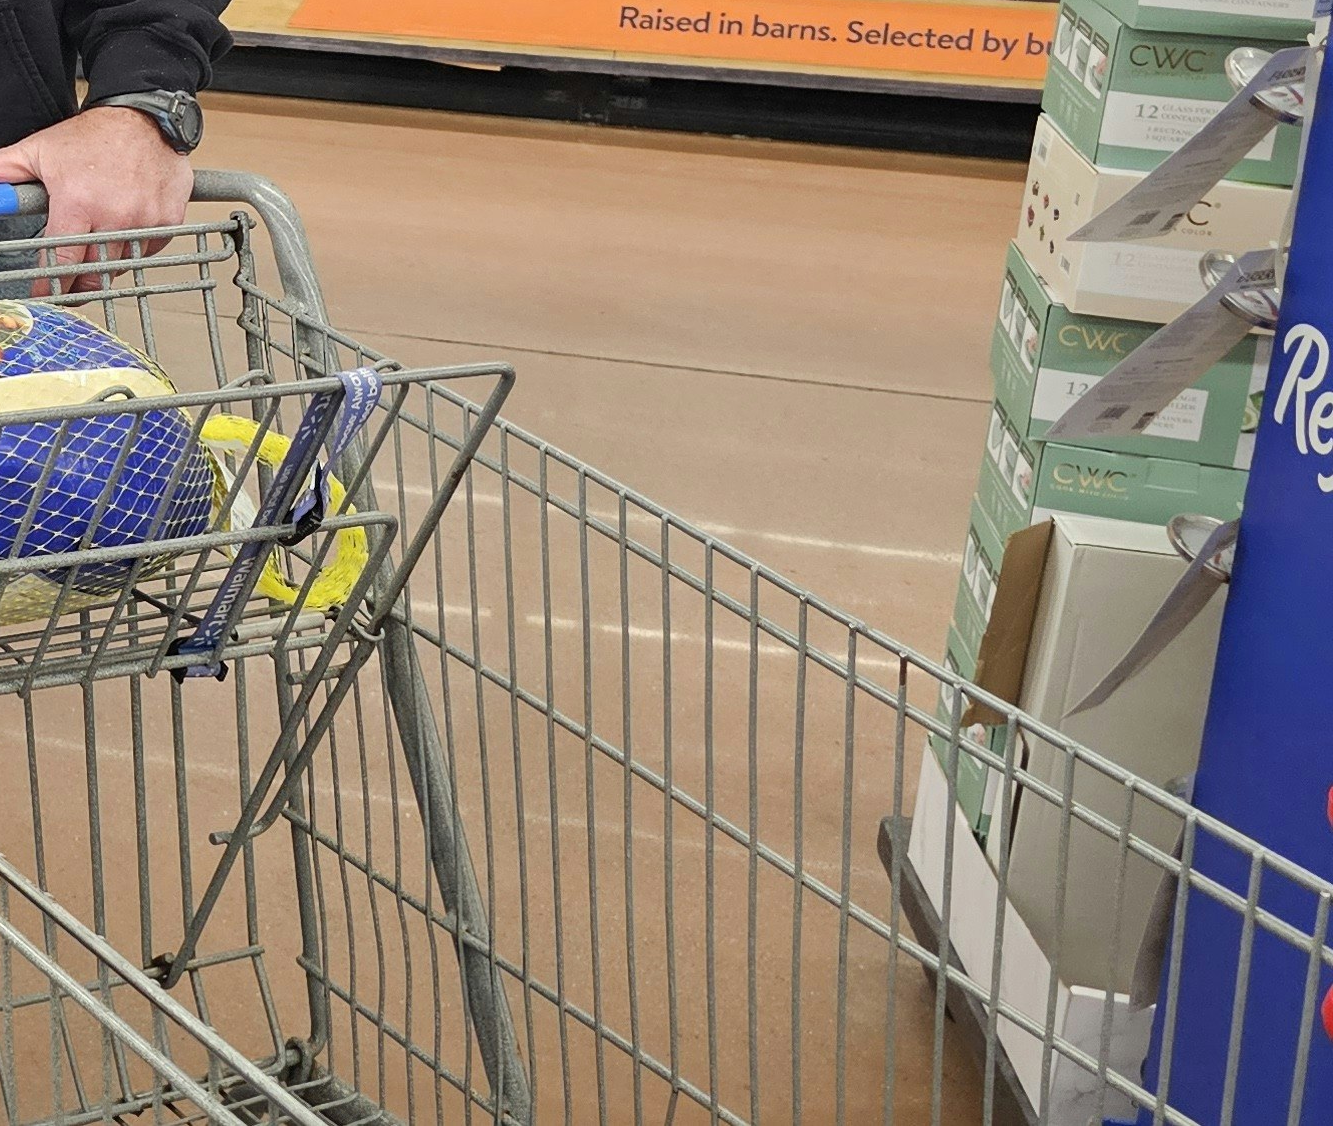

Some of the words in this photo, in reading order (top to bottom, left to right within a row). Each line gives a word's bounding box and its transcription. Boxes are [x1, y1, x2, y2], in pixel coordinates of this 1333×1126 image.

[619, 6, 709, 34] Raised
[719, 12, 743, 36] in
[752, 14, 837, 42] barns.
[846, 21, 974, 51] Selected
[982, 29, 1019, 61] by
[1129, 44, 1207, 72] CWC
[1135, 103, 1159, 119] 12
[1058, 324, 1131, 354] CWC
[1053, 462, 1128, 493] CWC
[213, 556, 257, 631] Walmart
